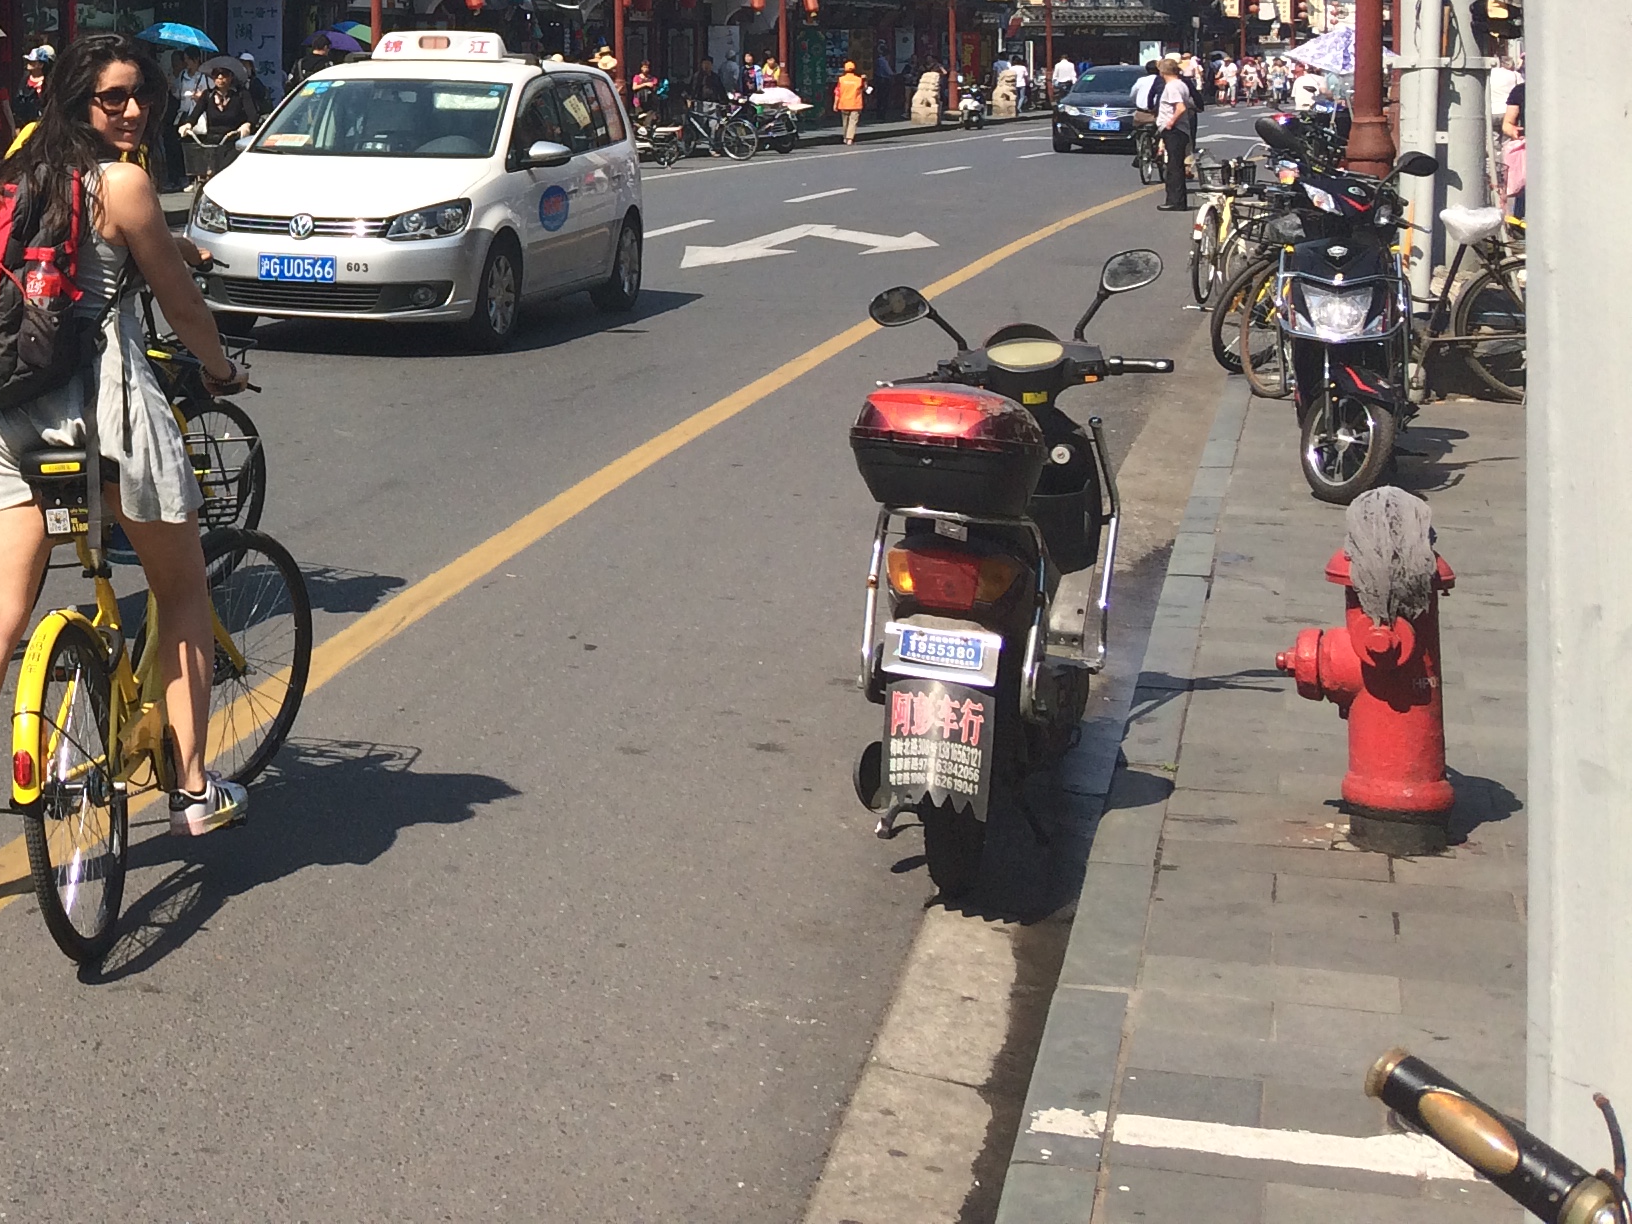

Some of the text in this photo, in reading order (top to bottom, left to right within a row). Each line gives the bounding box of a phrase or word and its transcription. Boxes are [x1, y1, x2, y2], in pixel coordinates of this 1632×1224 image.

[346, 262, 369, 273] 603
[909, 640, 976, 660] 1955380
[935, 758, 980, 783] 63842056
[934, 774, 979, 796] 62619041
